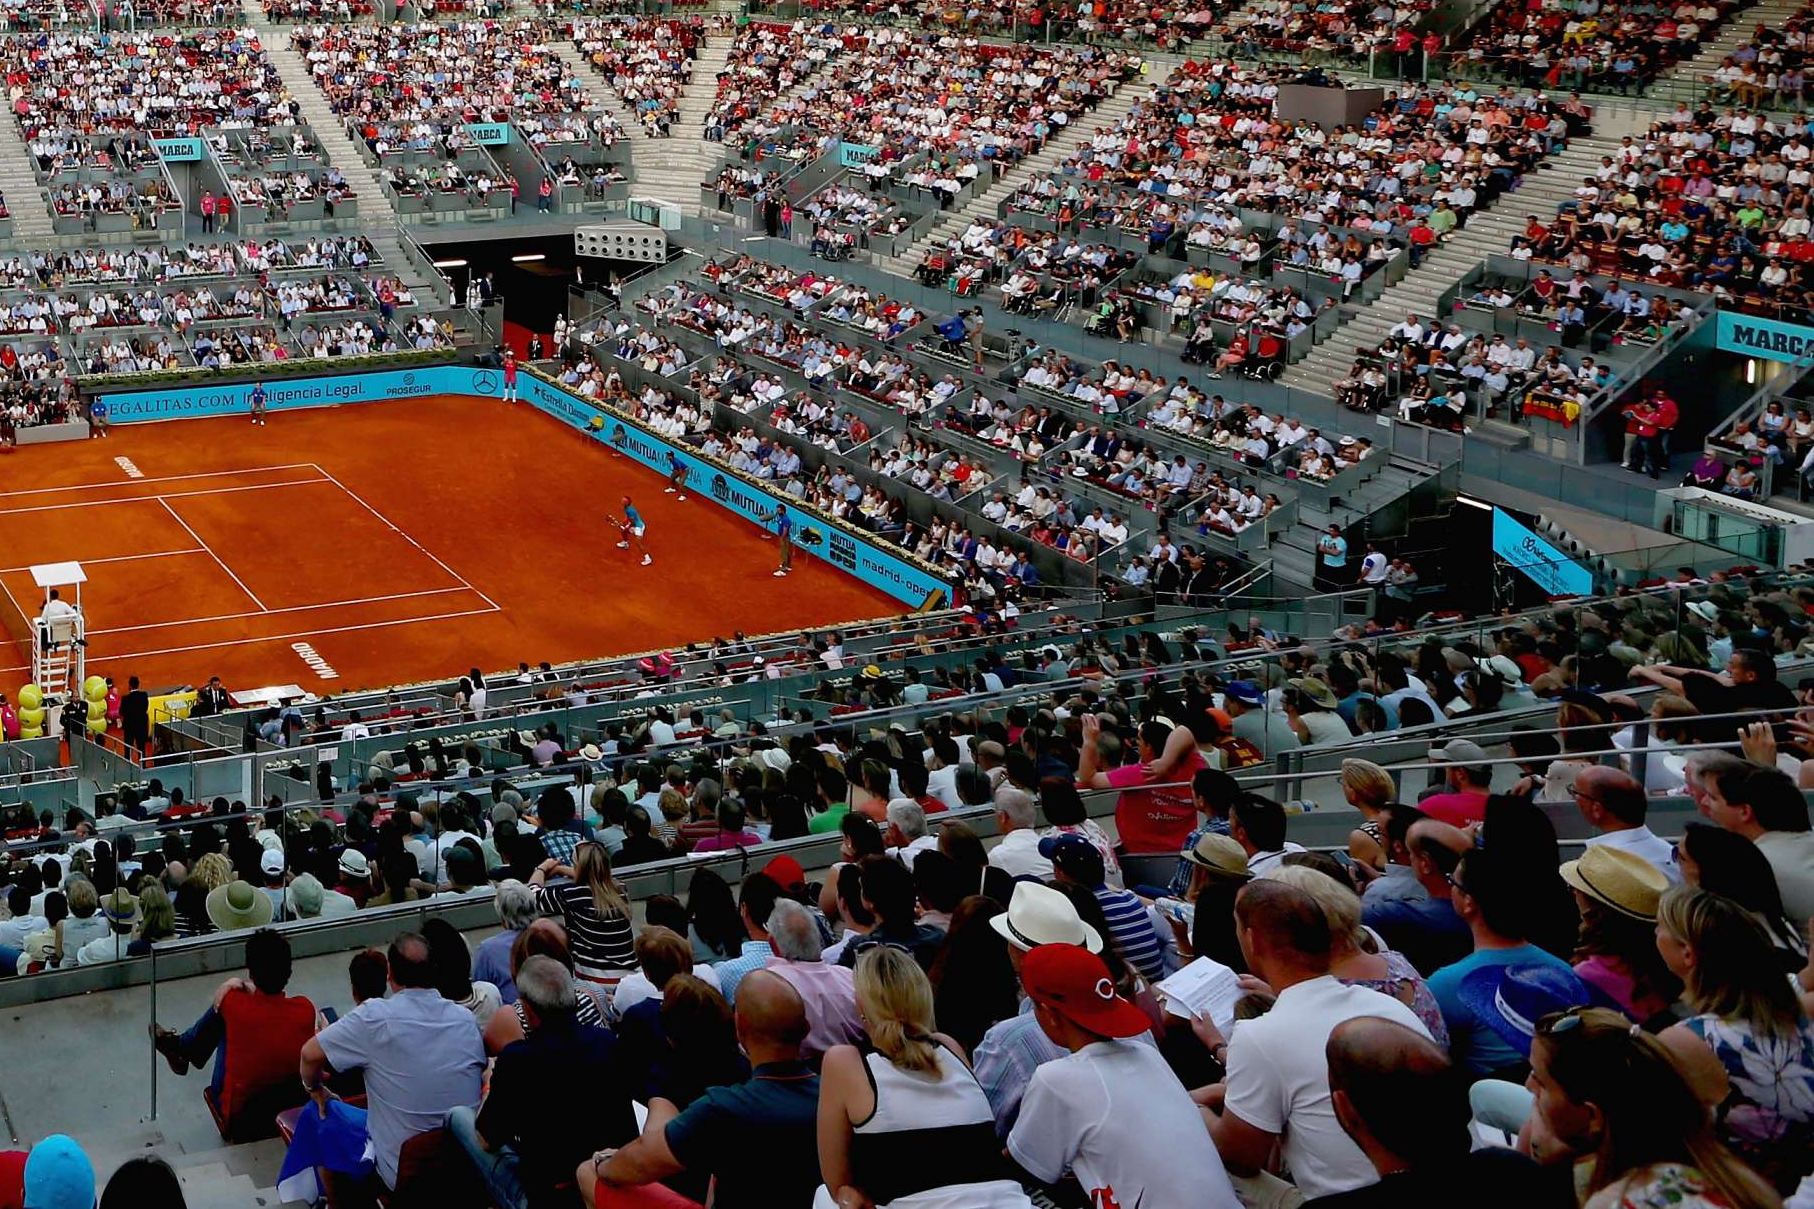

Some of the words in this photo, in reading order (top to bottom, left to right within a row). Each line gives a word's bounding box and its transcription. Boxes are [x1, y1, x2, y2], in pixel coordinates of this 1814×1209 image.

[326, 382, 366, 398] Legal.
[386, 385, 431, 396] PROSEGUR
[541, 391, 566, 412] Estrella
[629, 437, 657, 463] MUTUA
[731, 490, 764, 517] MUTUA
[830, 532, 857, 552] MUTUA
[291, 642, 340, 679] MADRID
[1096, 978, 1114, 999] C
